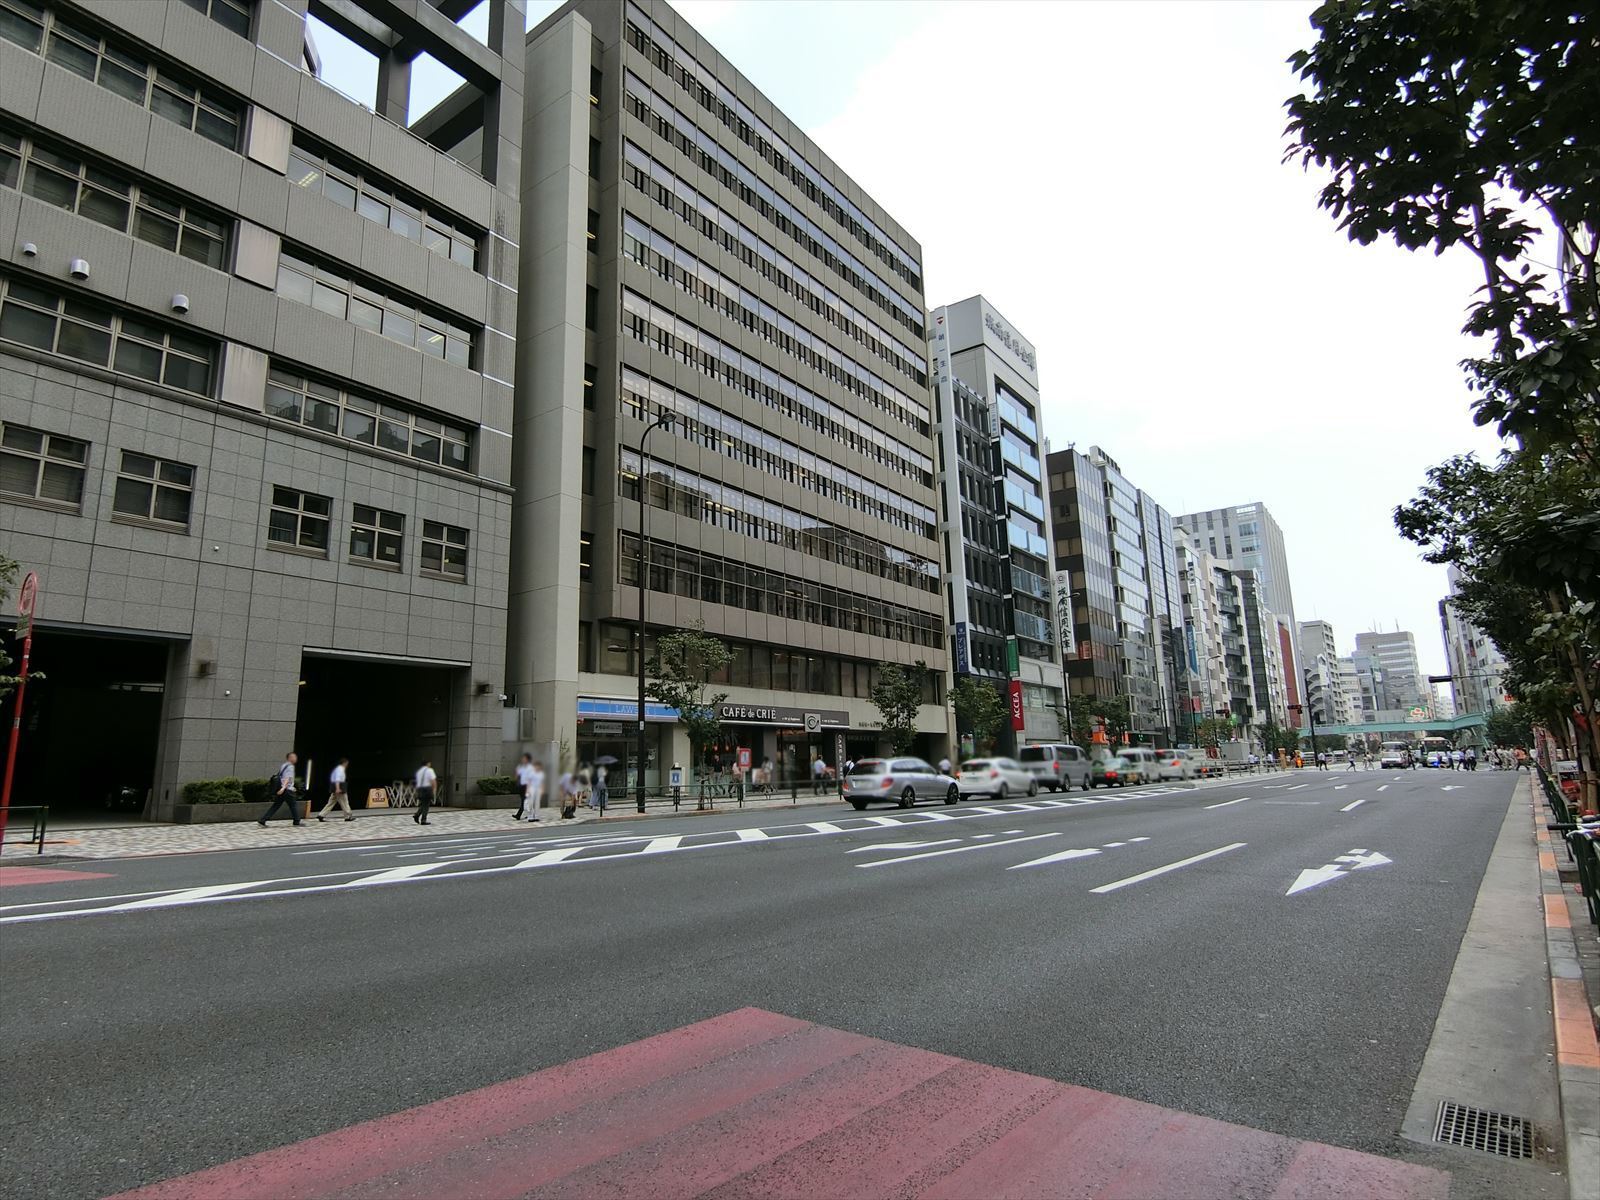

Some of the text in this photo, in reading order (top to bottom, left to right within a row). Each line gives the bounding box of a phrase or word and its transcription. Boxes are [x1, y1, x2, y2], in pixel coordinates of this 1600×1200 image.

[1057, 586, 1071, 649] 城南信用金庫
[722, 705, 746, 718] CAFÉ
[747, 707, 755, 718] de
[756, 707, 777, 720] CRIÉ
[1013, 692, 1021, 719] ACCEA
